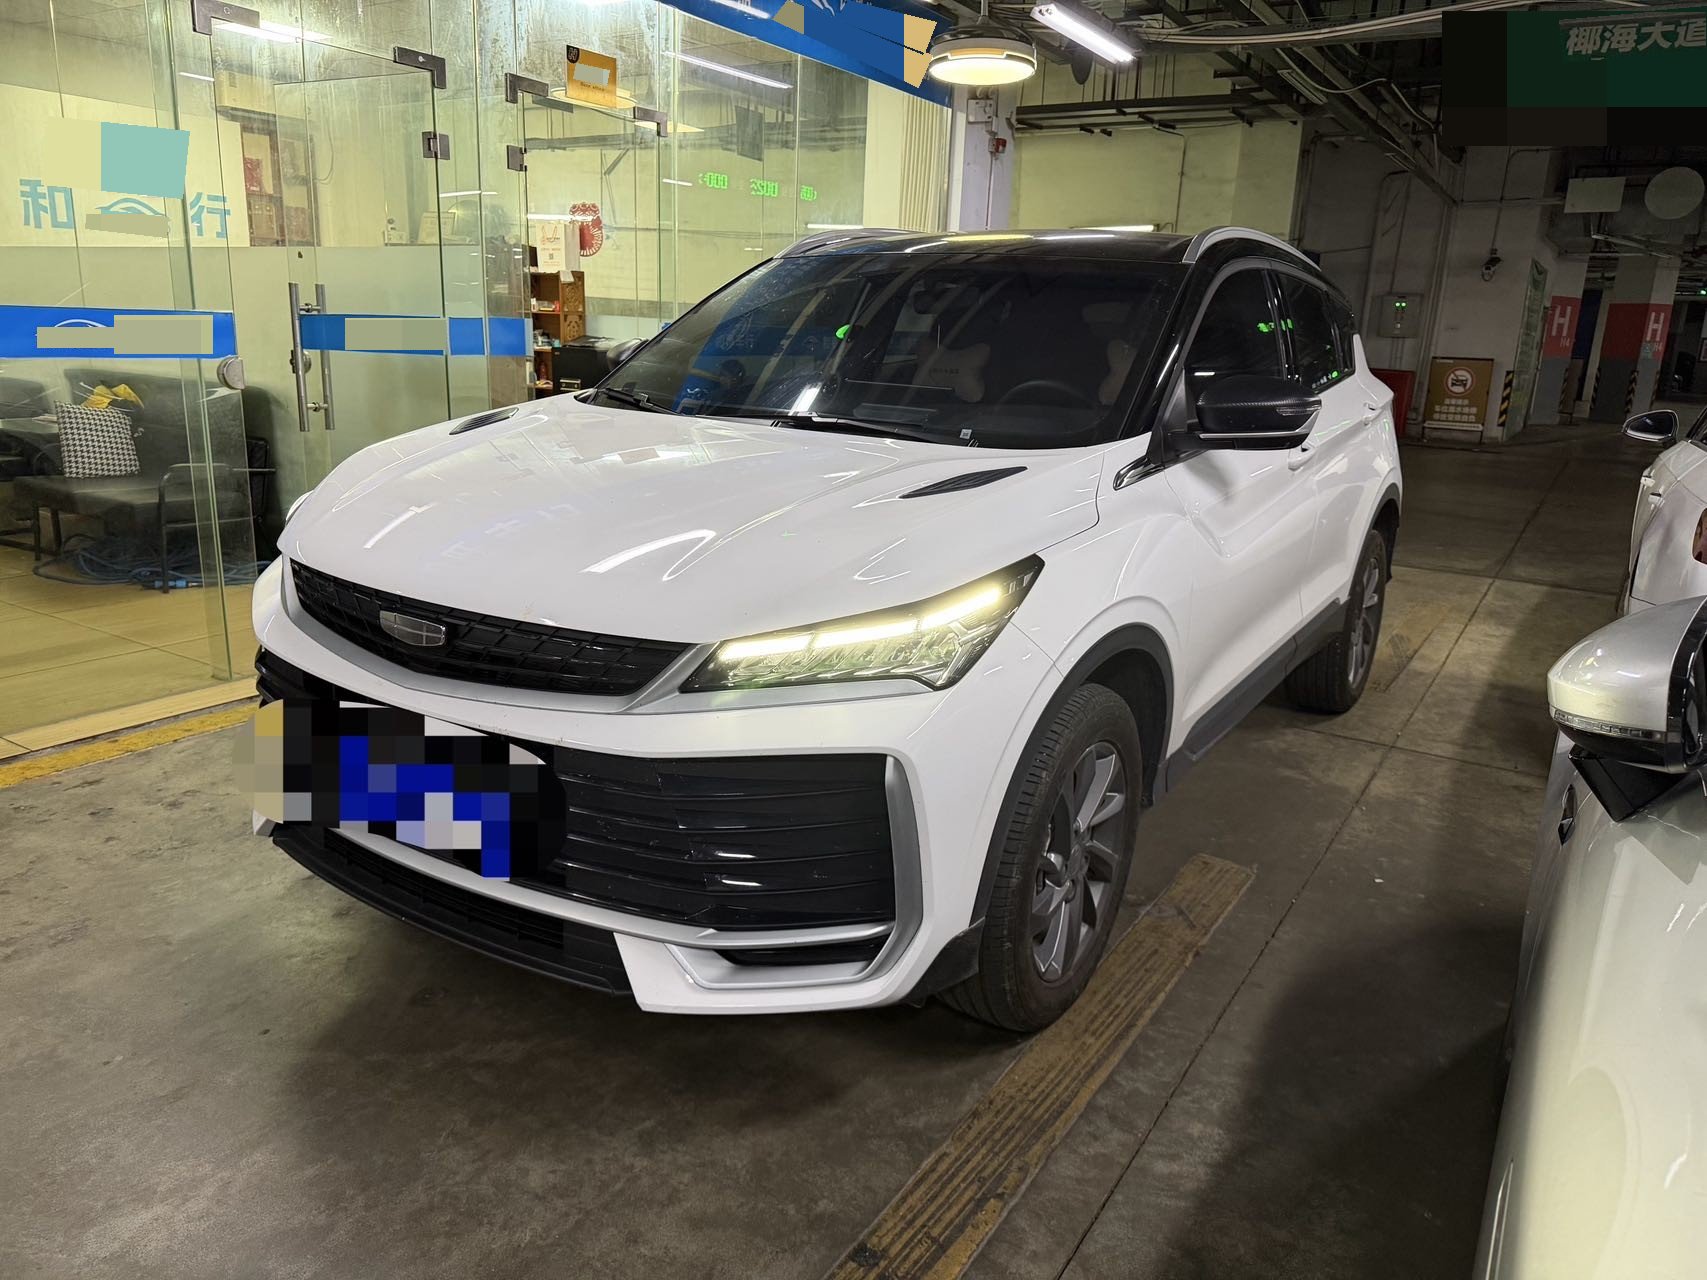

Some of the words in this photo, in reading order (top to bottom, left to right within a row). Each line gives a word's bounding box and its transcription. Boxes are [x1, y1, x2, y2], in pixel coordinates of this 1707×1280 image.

[1566, 18, 1707, 55] 椰海大道
[19, 178, 75, 229] 和
[190, 191, 231, 239] 行
[1552, 305, 1572, 337] H
[1647, 311, 1665, 342] H
